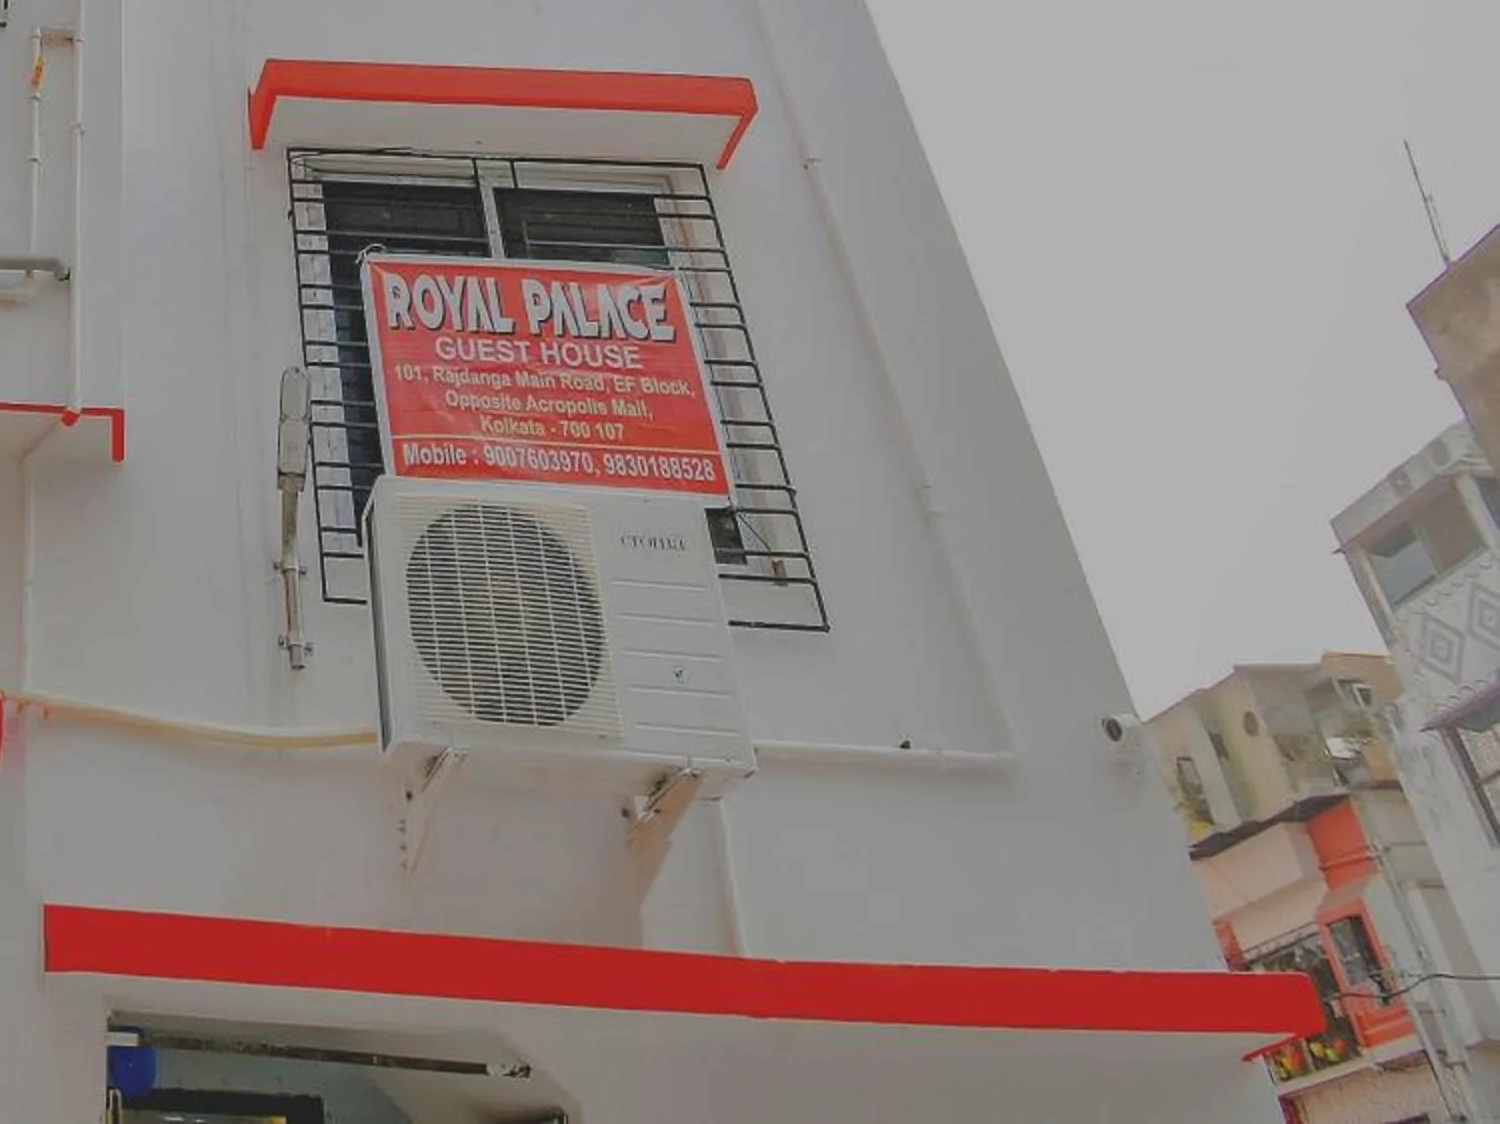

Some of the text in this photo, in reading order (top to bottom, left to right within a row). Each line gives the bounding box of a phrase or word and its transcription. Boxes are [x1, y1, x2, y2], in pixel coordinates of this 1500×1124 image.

[383, 273, 677, 342] ROYAL PALACE
[435, 336, 643, 369] GUEST HOUSE
[394, 364, 696, 397] 101, Rajdanga Main Road, EF Block,
[446, 390, 653, 420] Opposite Acropolis Mall,
[480, 418, 546, 436] Kolkata
[559, 419, 593, 438] 700
[597, 421, 624, 439] 107
[403, 443, 467, 466] Mobile
[484, 445, 601, 476] 9007603970,
[603, 453, 715, 481] 9830188528
